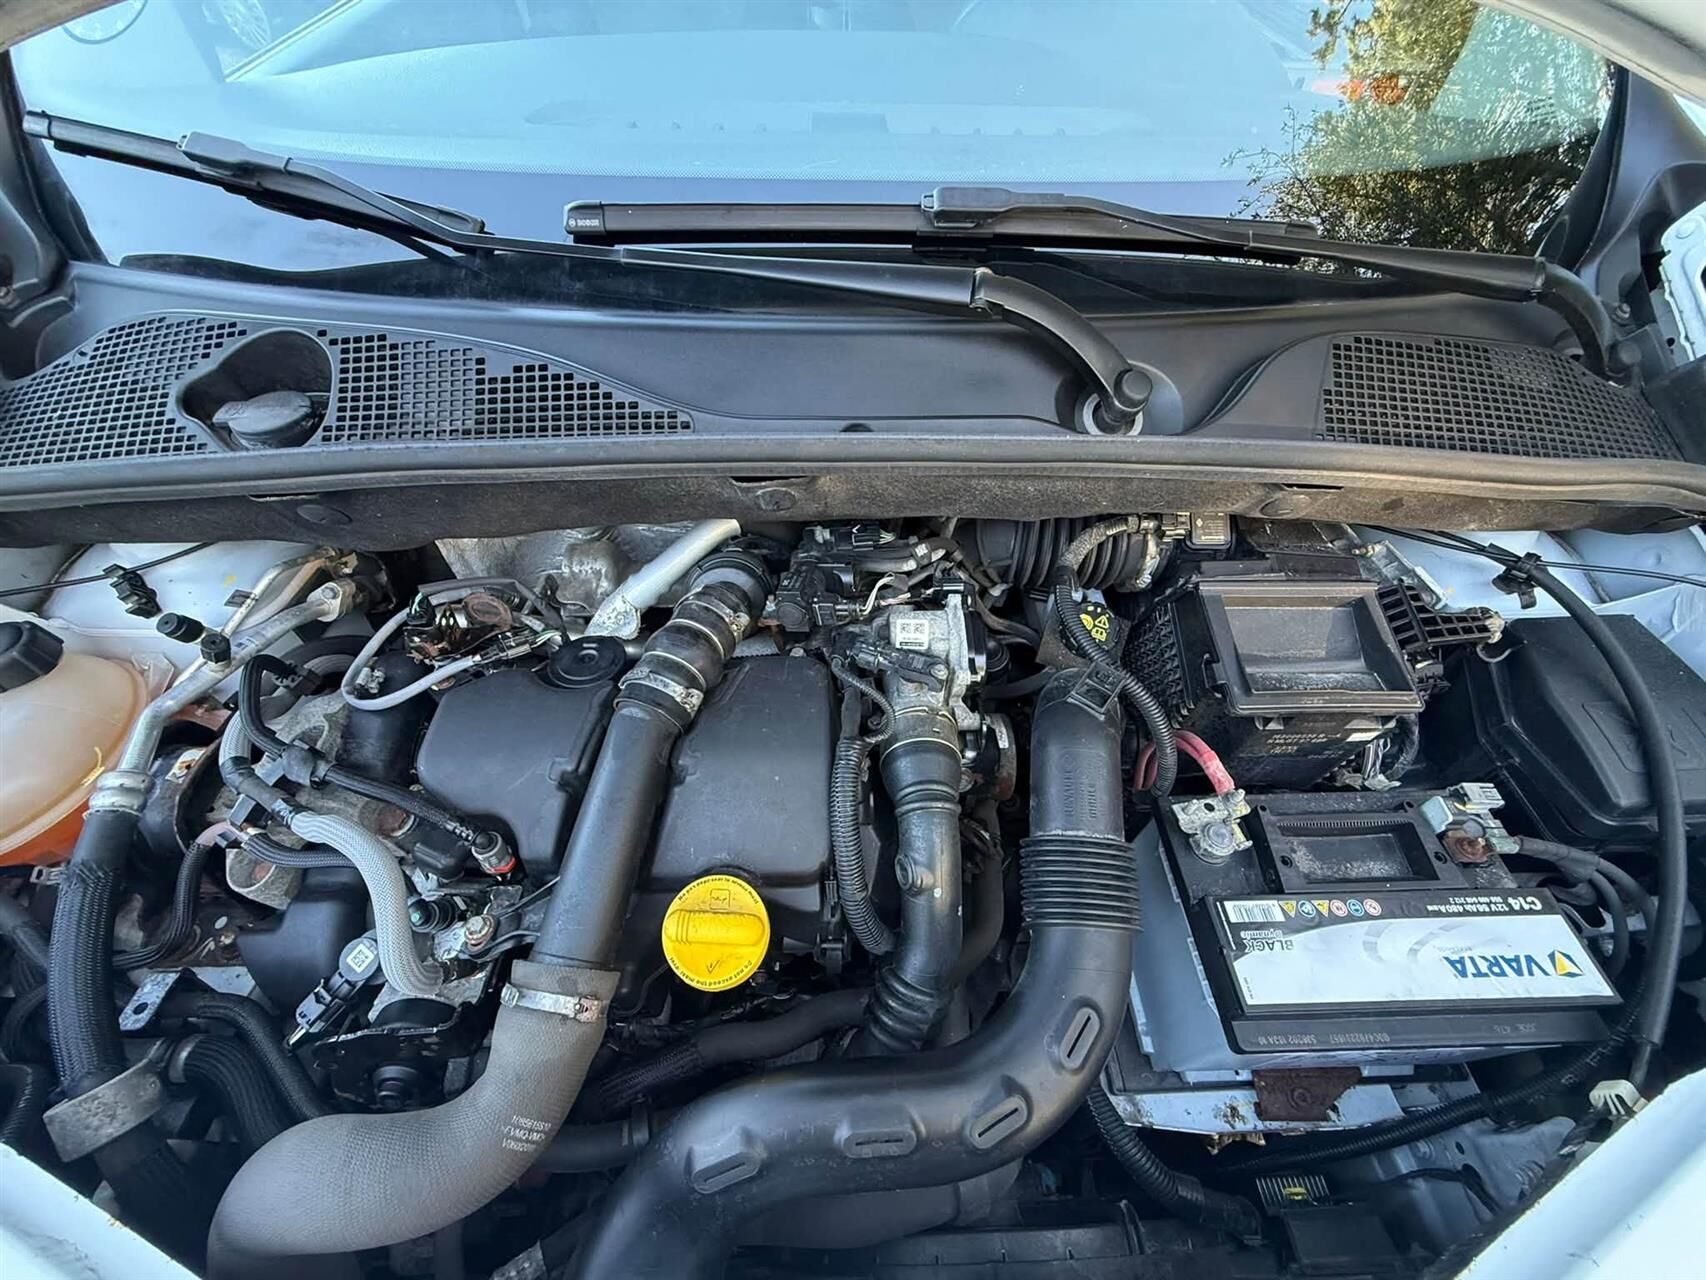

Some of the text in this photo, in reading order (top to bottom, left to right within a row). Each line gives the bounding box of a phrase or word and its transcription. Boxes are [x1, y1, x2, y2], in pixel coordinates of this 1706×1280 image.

[1490, 903, 1509, 911] 12V
[1506, 895, 1542, 911] C14
[1240, 928, 1283, 940] Dynamic
[1243, 940, 1294, 952] BLACK
[1443, 954, 1551, 979] VARTA
